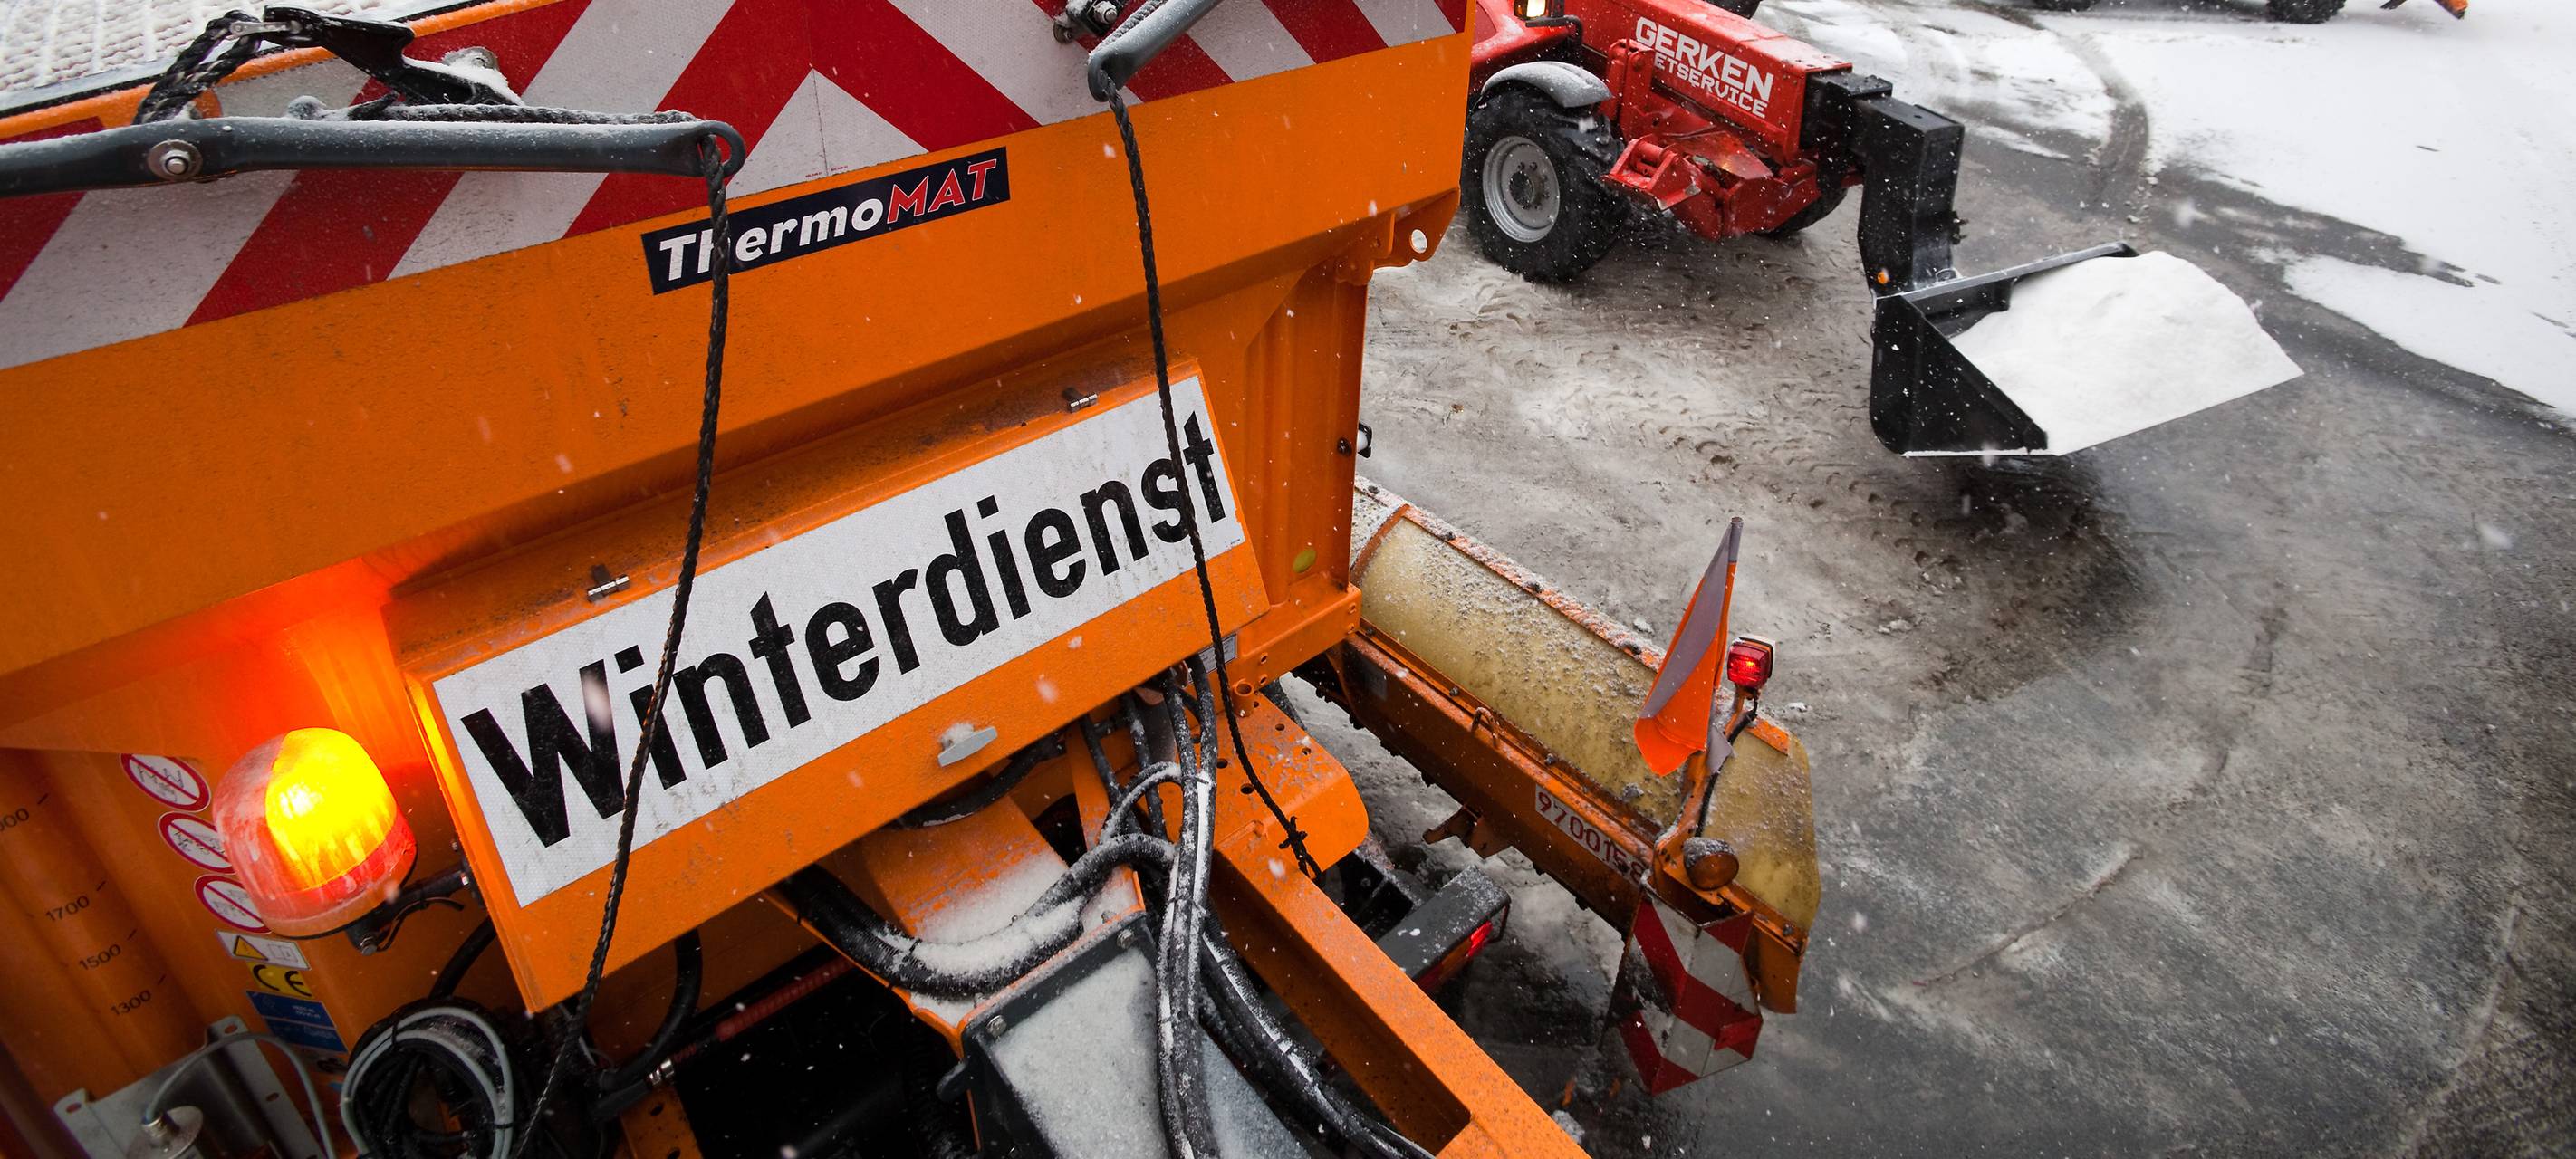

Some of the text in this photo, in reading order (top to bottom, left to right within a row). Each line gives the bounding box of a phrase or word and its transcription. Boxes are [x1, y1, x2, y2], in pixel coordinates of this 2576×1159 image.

[1636, 16, 1774, 102] GERKEN
[659, 158, 997, 282] ThermoMAT
[460, 410, 1226, 848] Winterdienst
[0, 808, 30, 831] 00
[46, 895, 90, 922] 1700
[79, 944, 121, 971] 1500
[110, 990, 151, 1016] 1300
